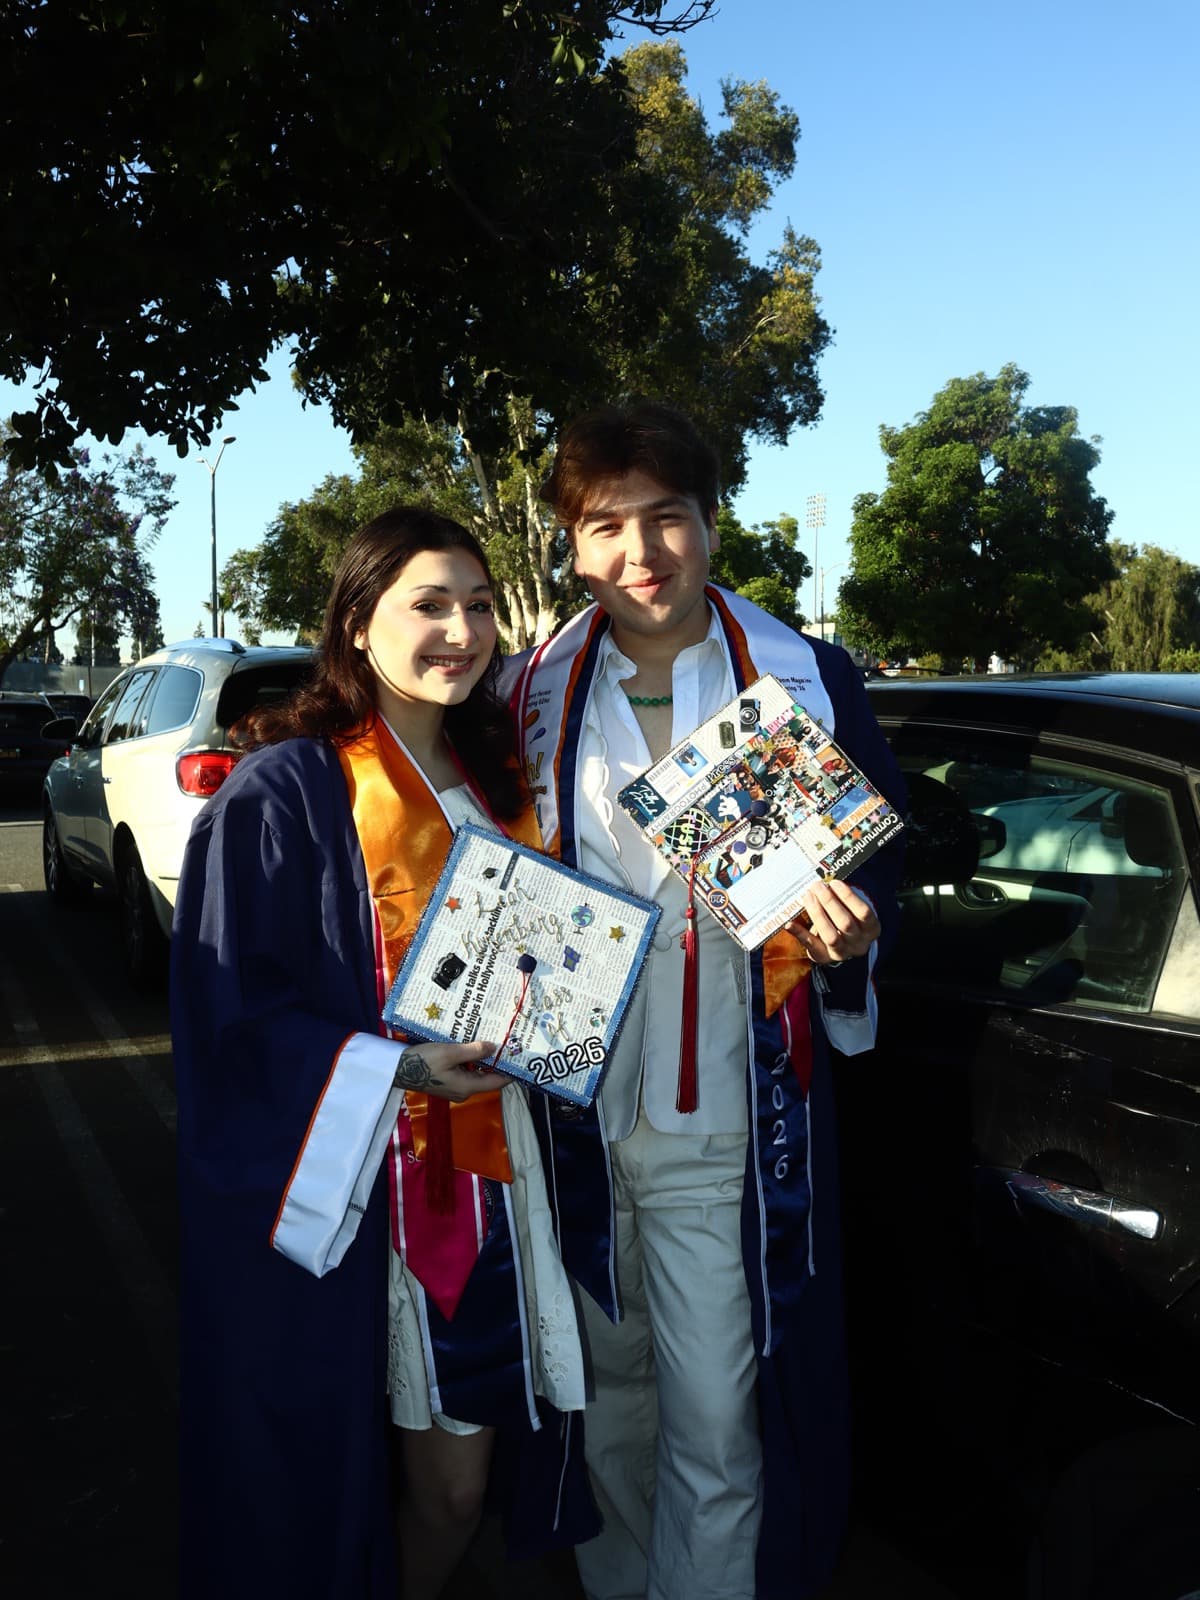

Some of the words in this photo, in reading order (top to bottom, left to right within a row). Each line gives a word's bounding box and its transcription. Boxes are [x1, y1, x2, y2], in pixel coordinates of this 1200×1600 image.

[649, 782, 706, 833] PHOTOGRAPHY
[465, 964, 480, 987] talks
[454, 988, 472, 1019] Crews
[462, 1002, 480, 1042] ardships
[472, 992, 484, 1003] in
[448, 1019, 461, 1039] erry
[546, 1013, 571, 1040] of
[528, 1037, 606, 1086] 2026
[770, 1052, 791, 1180] 2026
